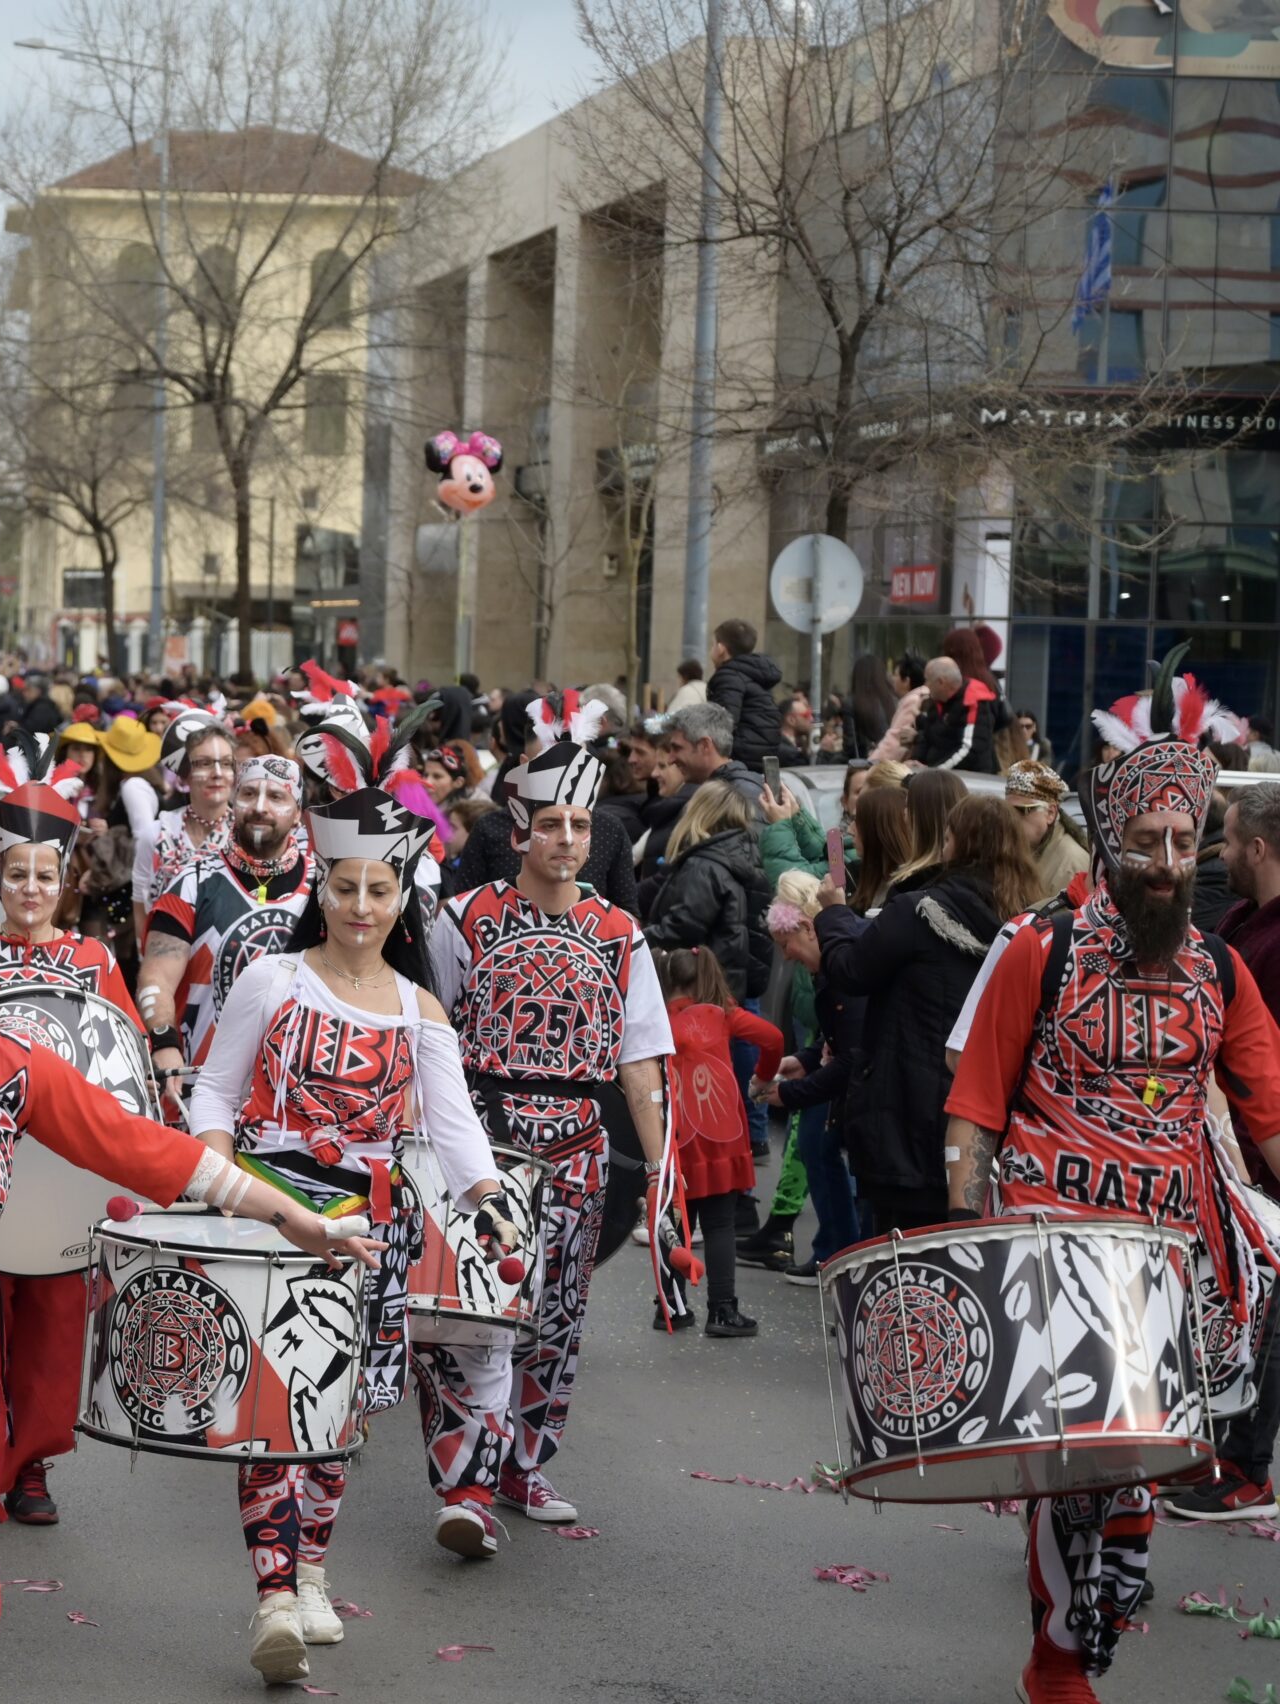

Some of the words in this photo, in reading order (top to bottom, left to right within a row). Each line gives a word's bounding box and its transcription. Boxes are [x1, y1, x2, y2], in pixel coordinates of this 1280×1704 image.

[981, 408, 1139, 428] MATRIX
[1158, 414, 1235, 430] ITNESS
[1242, 416, 1280, 431] STO
[237, 912, 294, 937] BATAL
[515, 1001, 570, 1048] 25
[1054, 1150, 1195, 1224] BATAL
[129, 1272, 217, 1310] BATALA
[864, 1266, 946, 1309] BATALA
[125, 1396, 213, 1426] SALOCA
[881, 1401, 958, 1434] MUNDO
